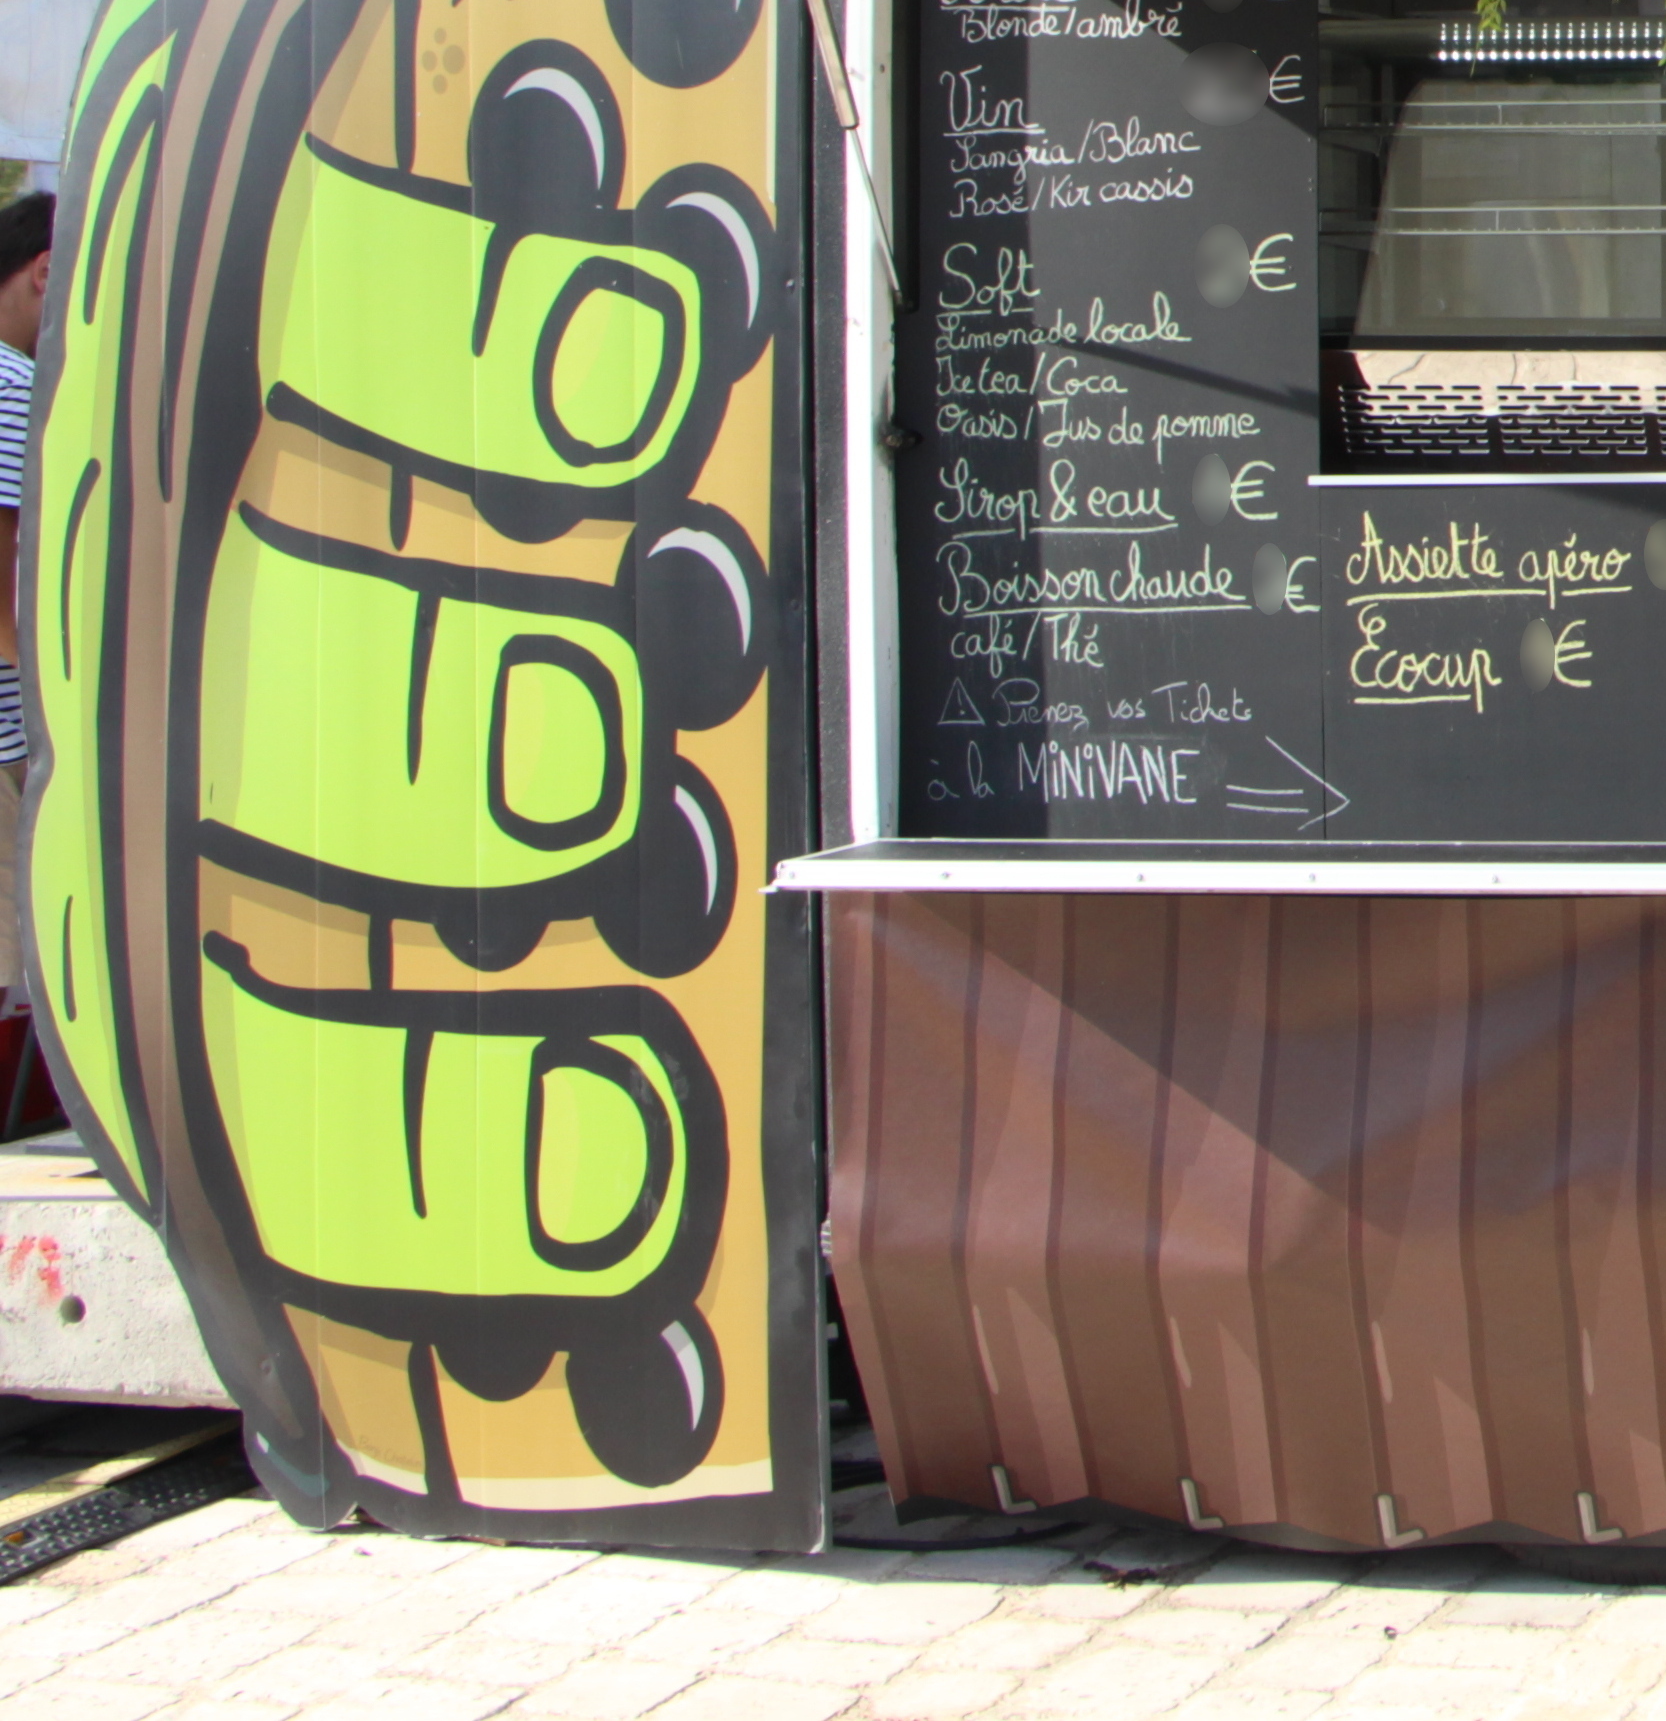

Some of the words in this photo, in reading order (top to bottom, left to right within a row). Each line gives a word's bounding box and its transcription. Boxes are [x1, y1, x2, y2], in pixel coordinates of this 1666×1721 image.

[939, 65, 1041, 131] Vin
[1099, 167, 1194, 202] cassis
[938, 242, 1041, 315] Soft
[935, 309, 1077, 352] Limonade
[1086, 291, 1192, 343] locale
[1108, 406, 1144, 445] de
[1152, 412, 1261, 465] pomme
[934, 457, 1041, 541] Sirop
[1050, 458, 1077, 522] &
[1087, 486, 1175, 521] eau
[936, 541, 1106, 616] Boisson
[1110, 540, 1246, 603] chaude
[1347, 510, 1504, 585] Assiette
[1518, 533, 1631, 610] apéro
[992, 678, 1089, 730] Prenez
[1107, 698, 1147, 719] vos
[1151, 681, 1252, 724] Tickets
[927, 760, 960, 801] à
[968, 740, 994, 796] la
